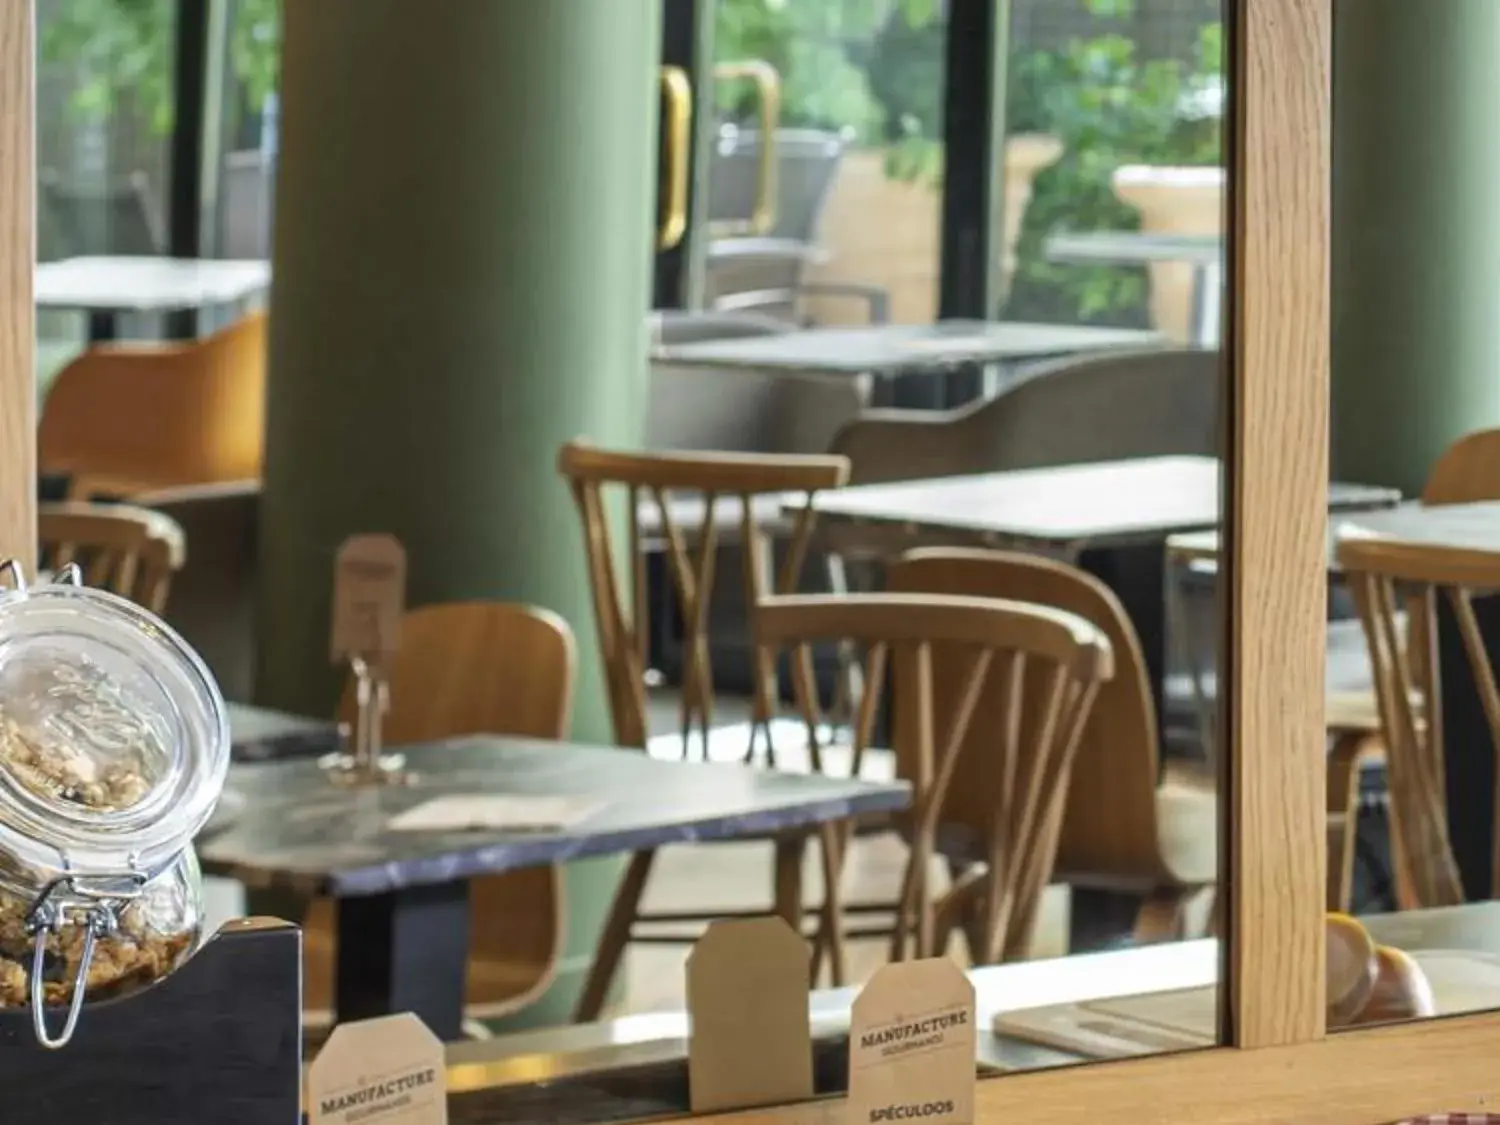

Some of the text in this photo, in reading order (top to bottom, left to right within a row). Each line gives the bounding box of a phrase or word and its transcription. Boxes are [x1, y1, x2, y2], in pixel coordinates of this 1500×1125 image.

[861, 1011, 967, 1048] MANUFACTURE
[321, 1068, 435, 1116] MANUFACTURE
[869, 1100, 954, 1123] SPÉCULOOS
